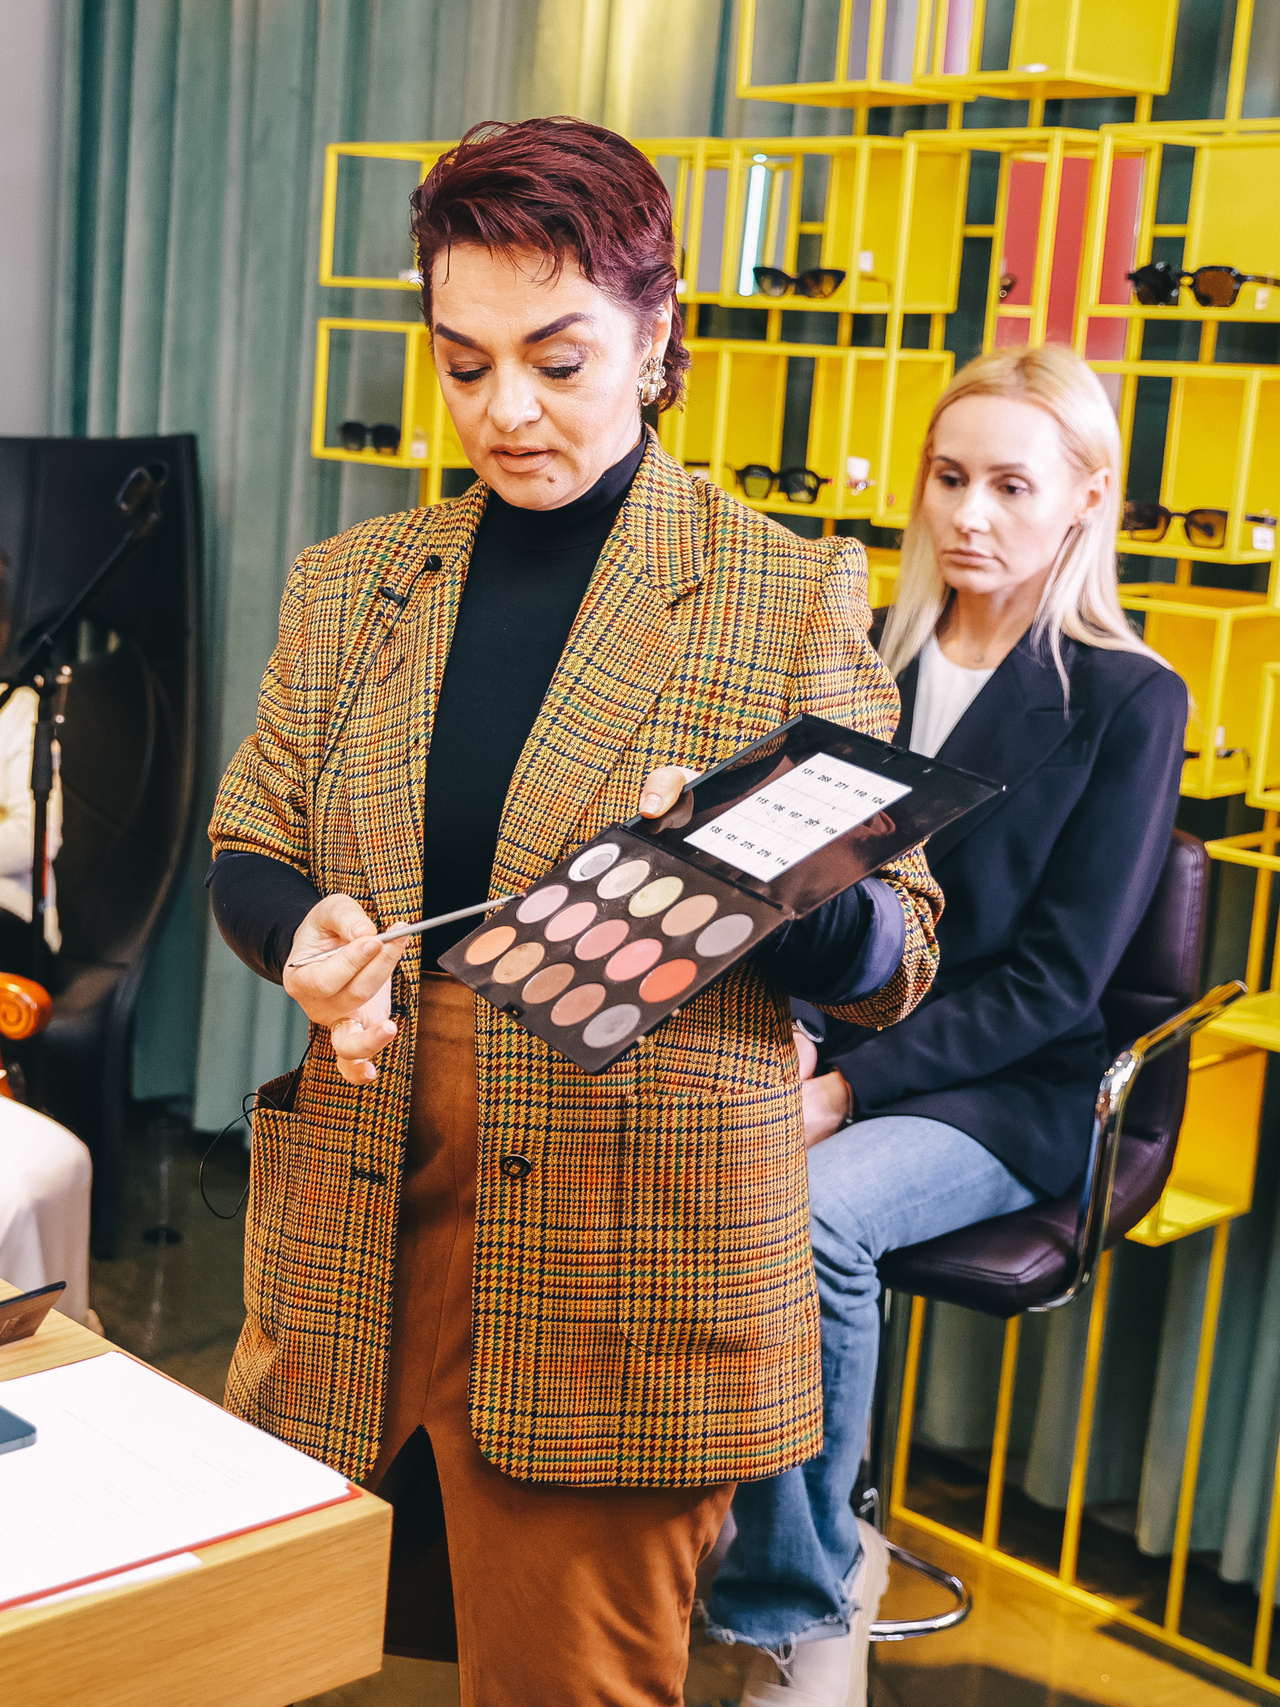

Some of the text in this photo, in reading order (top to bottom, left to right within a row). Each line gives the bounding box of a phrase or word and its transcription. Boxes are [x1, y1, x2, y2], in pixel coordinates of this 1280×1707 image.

[800, 768, 815, 776] 131
[834, 781, 850, 790] 271
[852, 789, 868, 798] 110
[755, 796, 770, 805] 115
[789, 811, 803, 819] 107
[708, 825, 723, 834] 135
[724, 833, 738, 841] 121
[775, 857, 788, 866] 114
